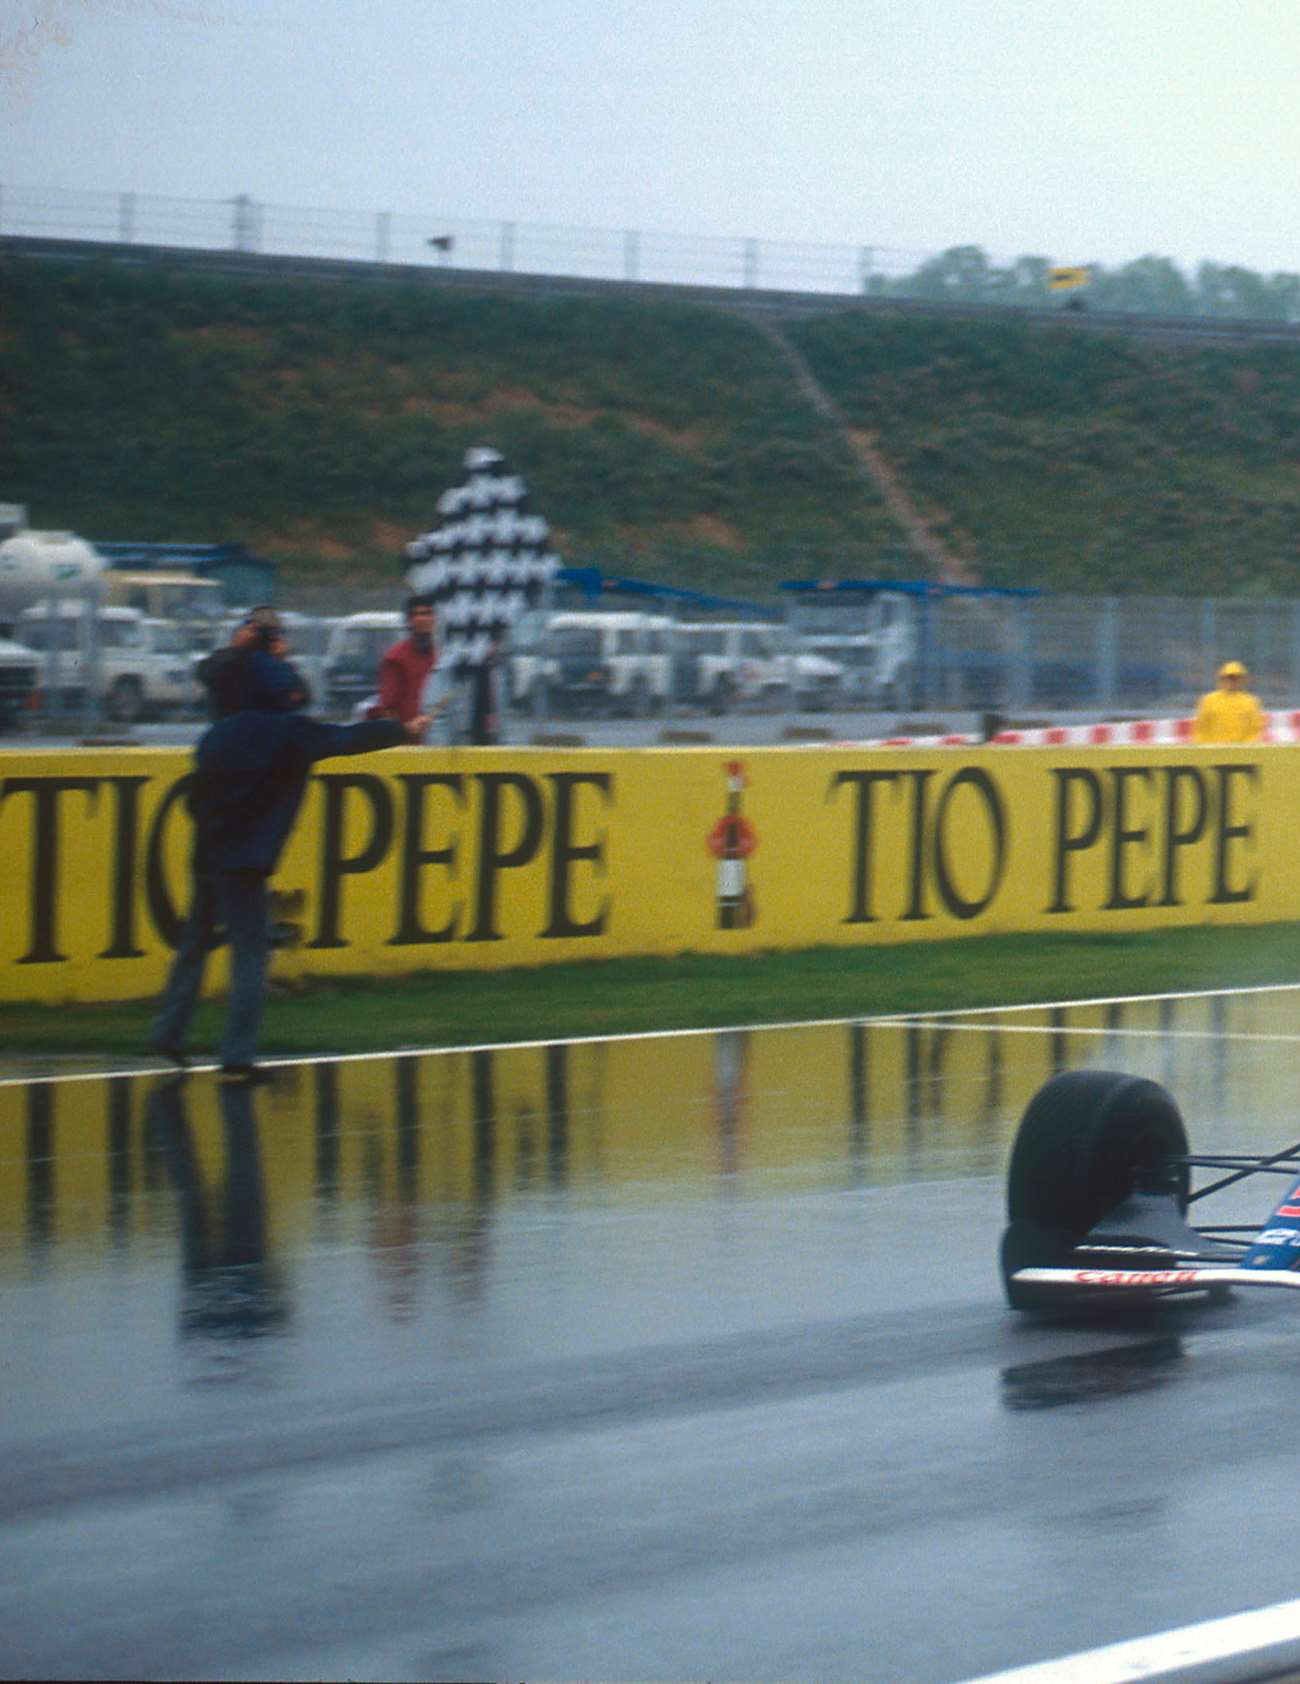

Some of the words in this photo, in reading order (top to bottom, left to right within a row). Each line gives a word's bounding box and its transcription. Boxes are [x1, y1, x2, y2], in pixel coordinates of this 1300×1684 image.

[307, 770, 616, 949] PEPE
[826, 767, 1009, 924] TIO
[1045, 764, 1260, 914] PEPE
[1074, 1267, 1200, 1286] Canon
